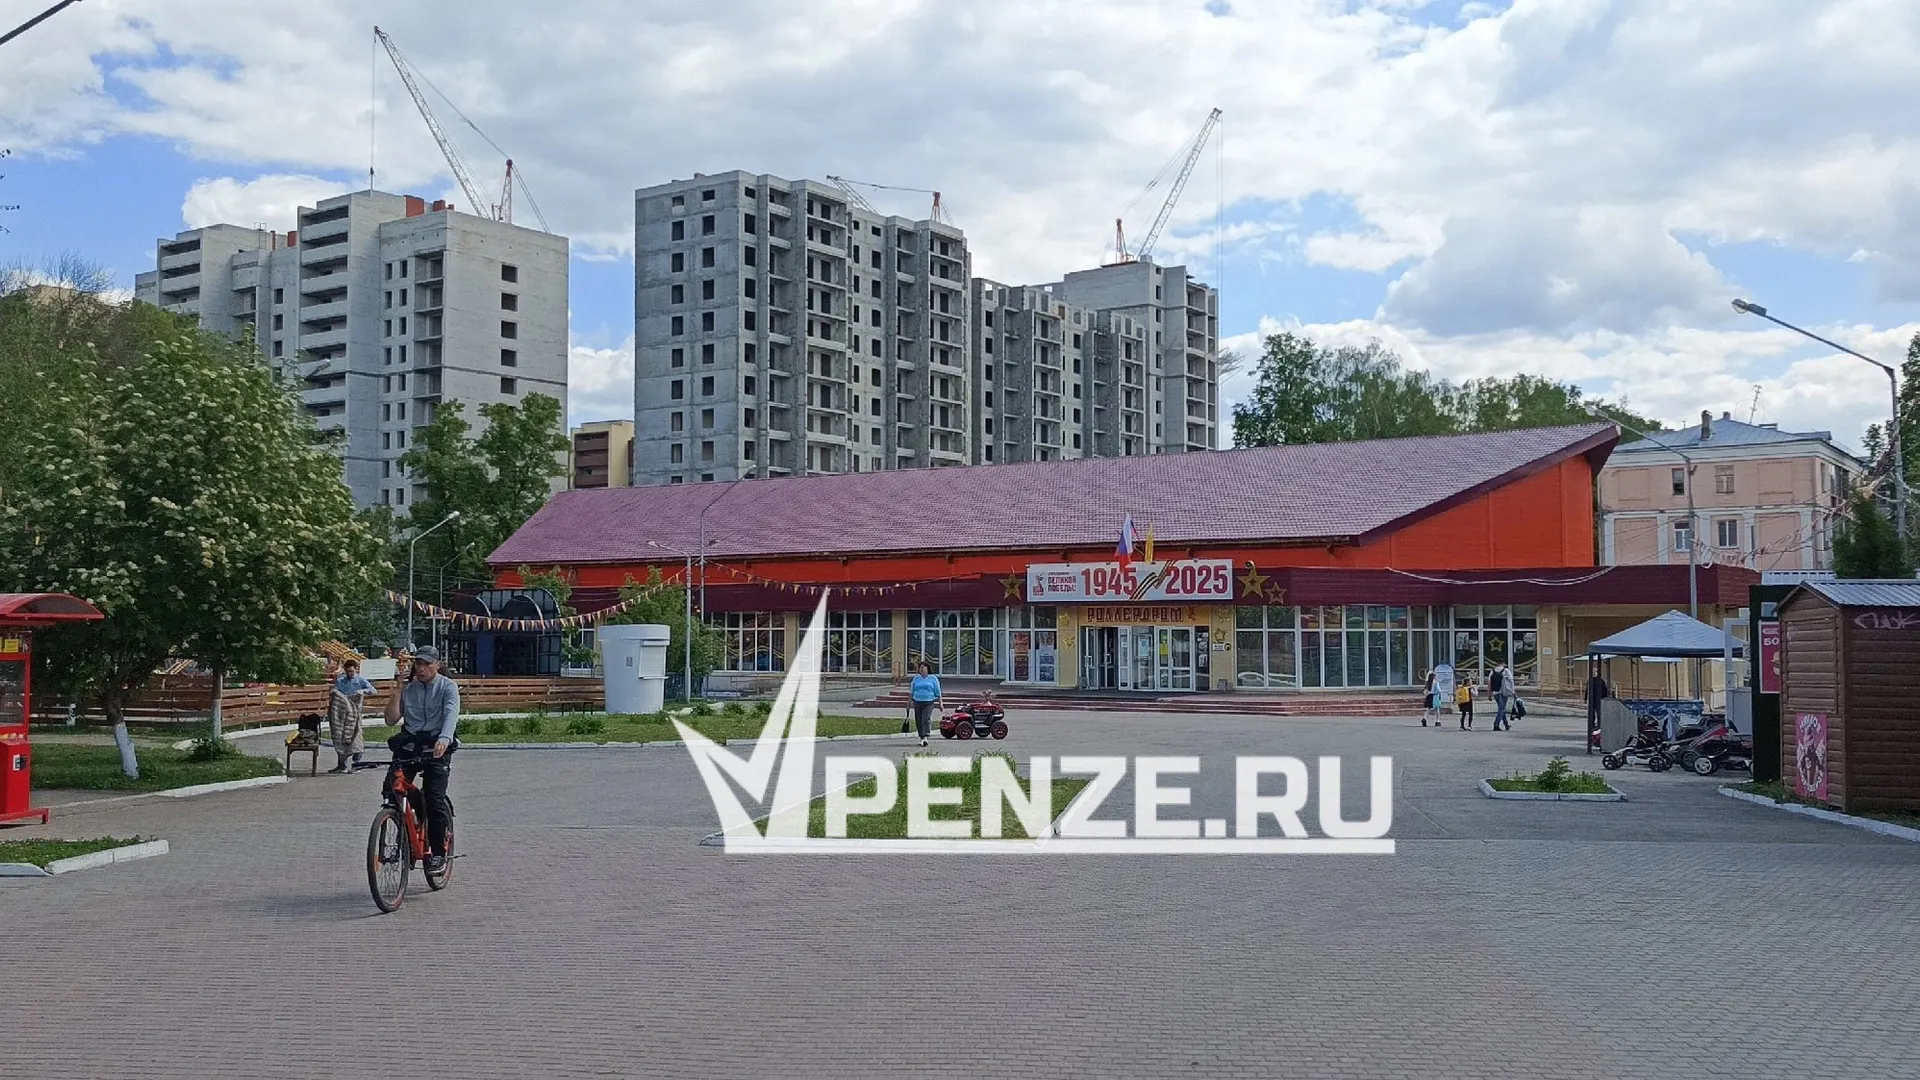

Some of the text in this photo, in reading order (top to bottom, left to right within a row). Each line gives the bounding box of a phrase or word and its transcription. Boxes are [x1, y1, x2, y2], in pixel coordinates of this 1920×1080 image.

[1081, 567, 1138, 596] 1945
[1165, 565, 1229, 595] 2025
[1087, 606, 1184, 623] РОЛЛЕРДРОМ
